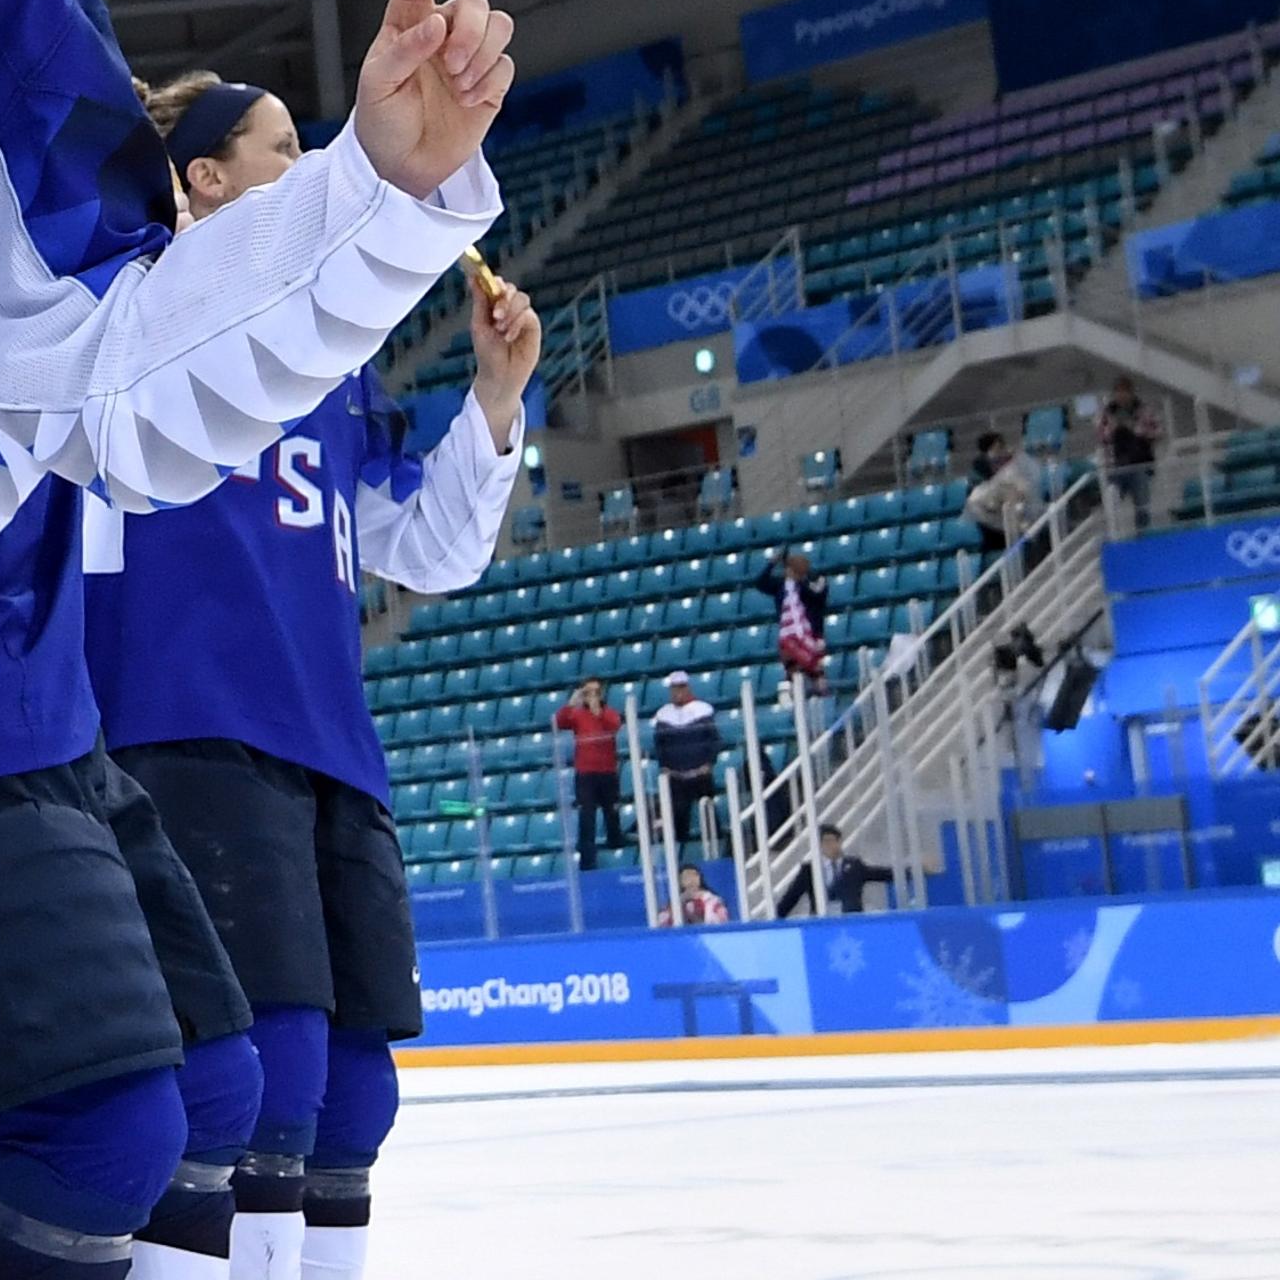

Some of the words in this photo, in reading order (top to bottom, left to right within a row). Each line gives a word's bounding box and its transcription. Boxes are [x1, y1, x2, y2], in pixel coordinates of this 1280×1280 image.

[228, 435, 356, 594] SA
[421, 978, 565, 1017] eongChang
[565, 972, 630, 1005] 2018
